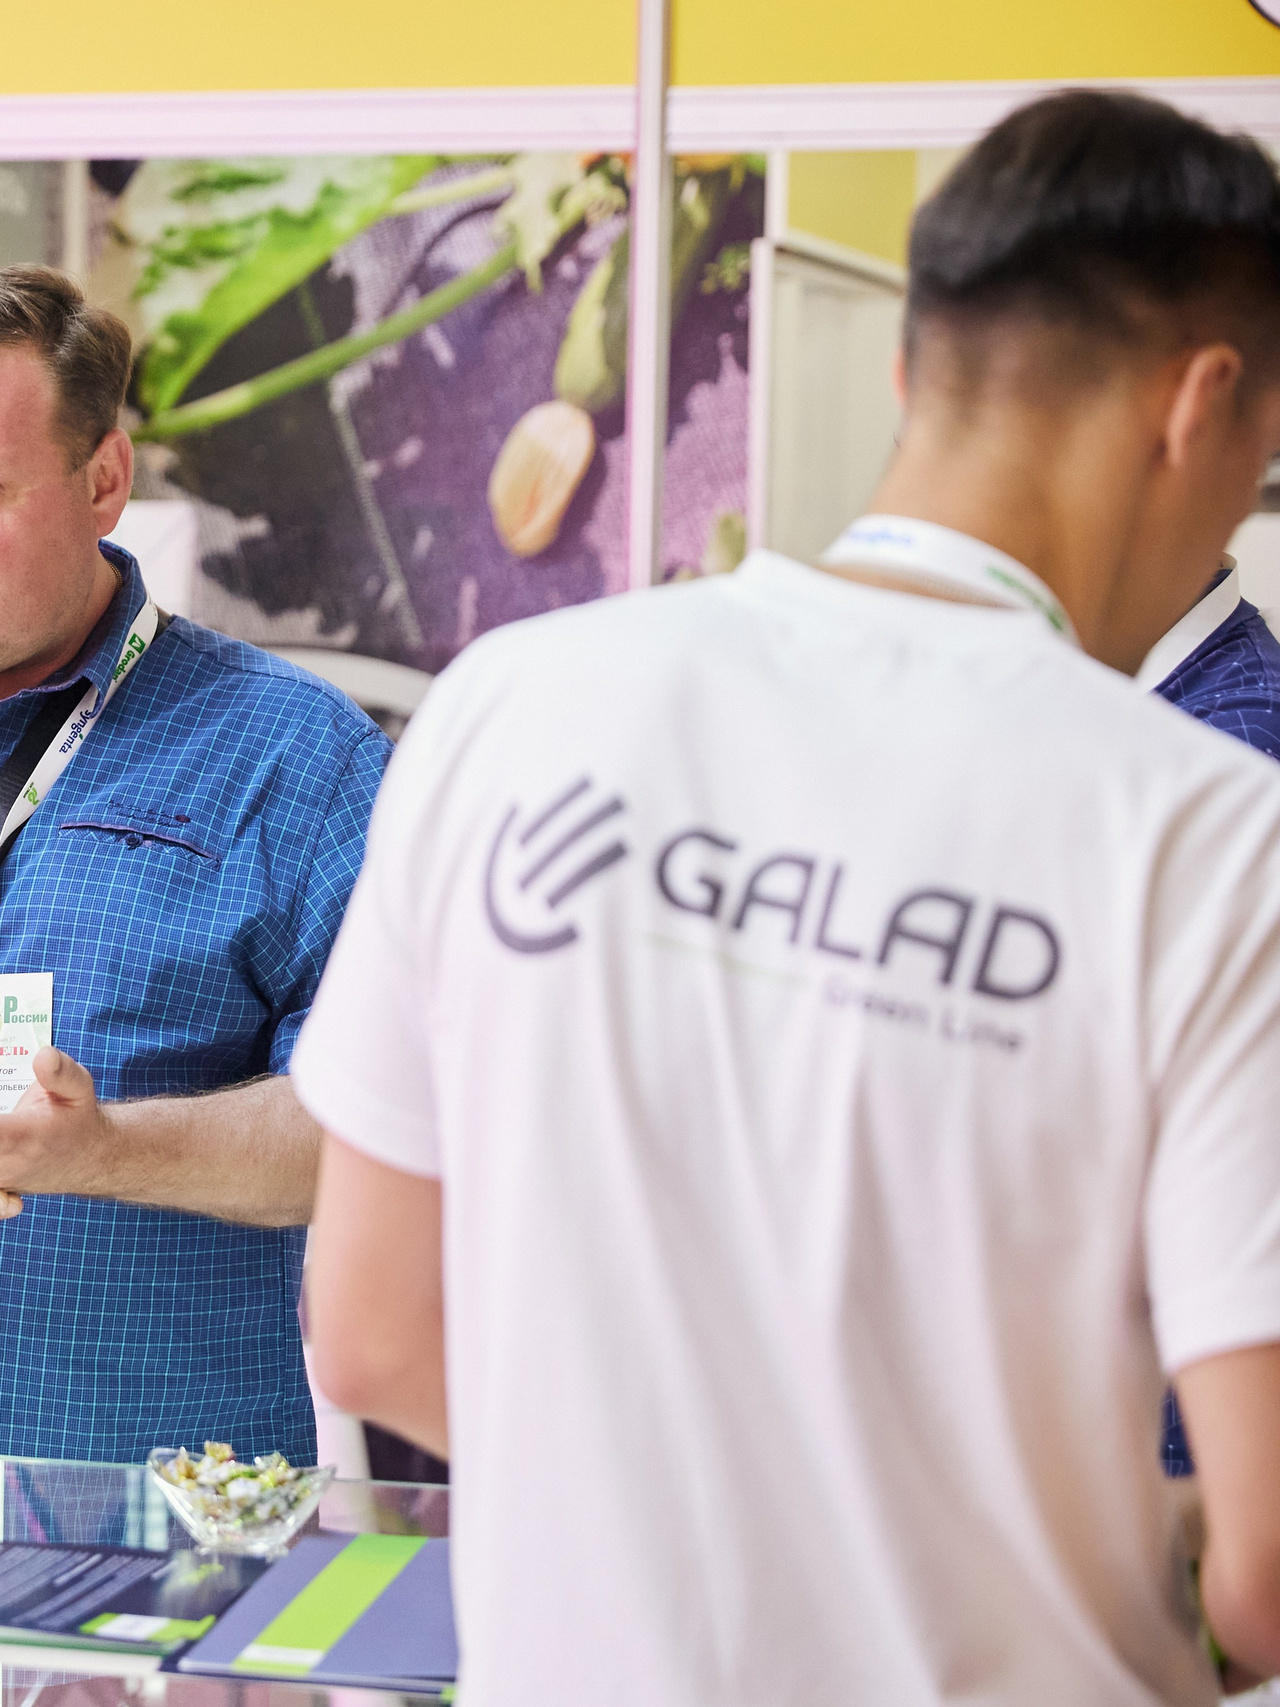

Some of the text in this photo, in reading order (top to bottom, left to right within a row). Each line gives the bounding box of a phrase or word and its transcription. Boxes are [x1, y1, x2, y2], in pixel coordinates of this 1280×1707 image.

[112, 650, 135, 681] Grodan
[59, 709, 92, 754] syngenta
[654, 827, 1062, 1002] GALAD
[4, 996, 48, 1024] России
